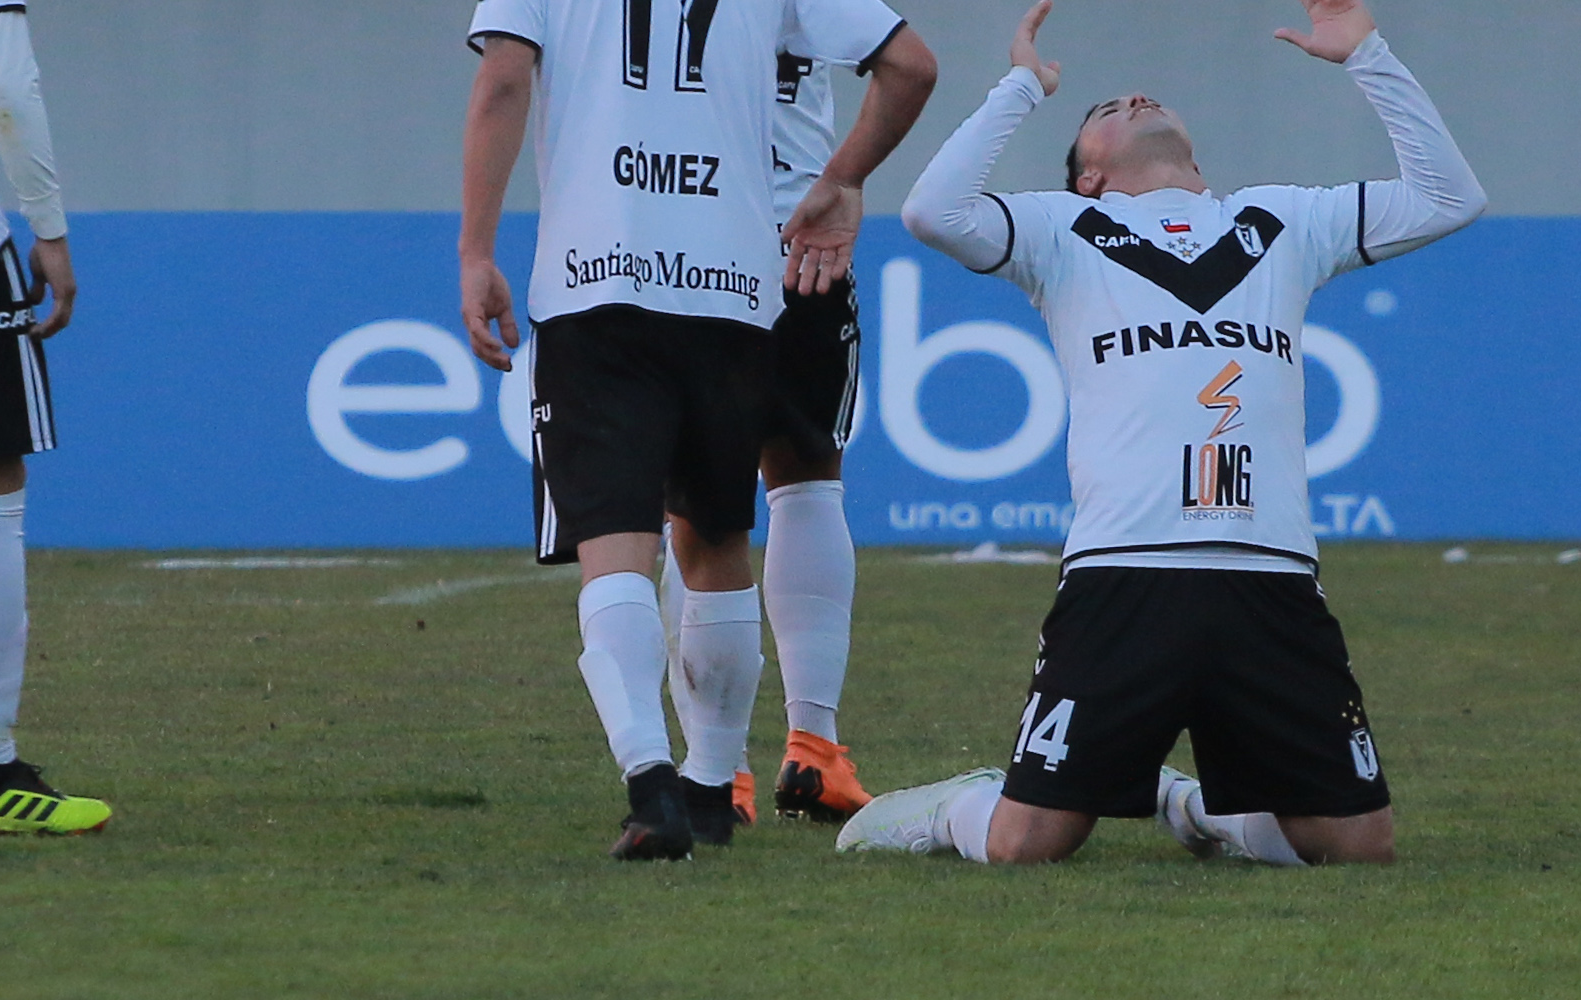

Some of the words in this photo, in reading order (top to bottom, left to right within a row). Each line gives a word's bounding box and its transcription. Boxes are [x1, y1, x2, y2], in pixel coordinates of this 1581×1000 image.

[613, 141, 721, 198] GÓMEZ
[565, 242, 653, 294] Santiago
[654, 250, 760, 311] Morning
[1091, 320, 1294, 366] FINASUR
[1181, 443, 1253, 508] LONG
[888, 502, 981, 531] una
[1182, 511, 1225, 521] ENERGY
[1012, 691, 1075, 772] 14
